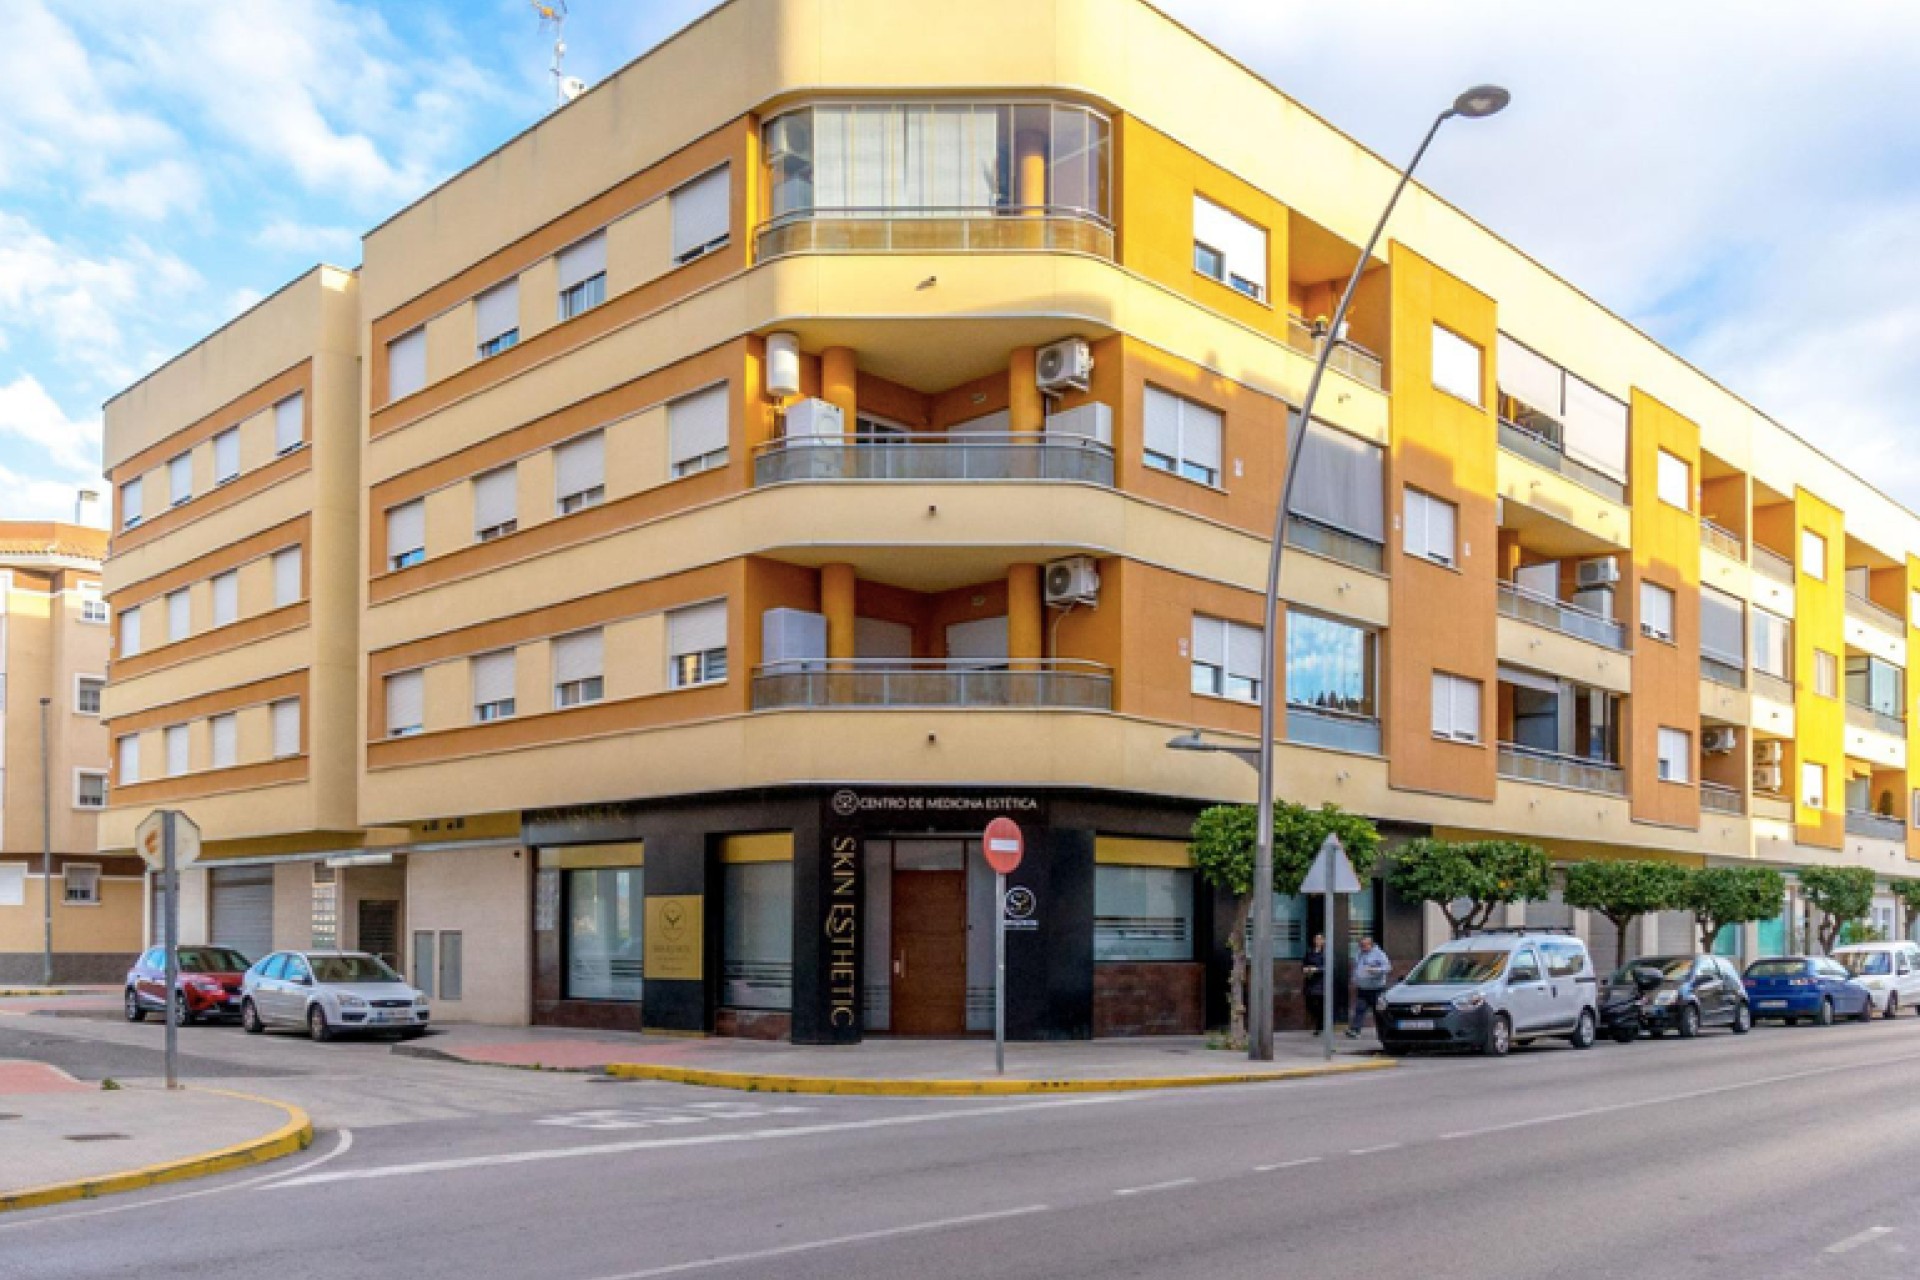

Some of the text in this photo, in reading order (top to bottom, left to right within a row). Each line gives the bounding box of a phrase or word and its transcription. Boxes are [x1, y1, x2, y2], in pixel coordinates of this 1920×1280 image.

[860, 797, 906, 810] CENTRO
[908, 797, 924, 810] DE
[926, 797, 984, 810] MEDICINA
[825, 837, 856, 1026] SKIN ESTHETIC
